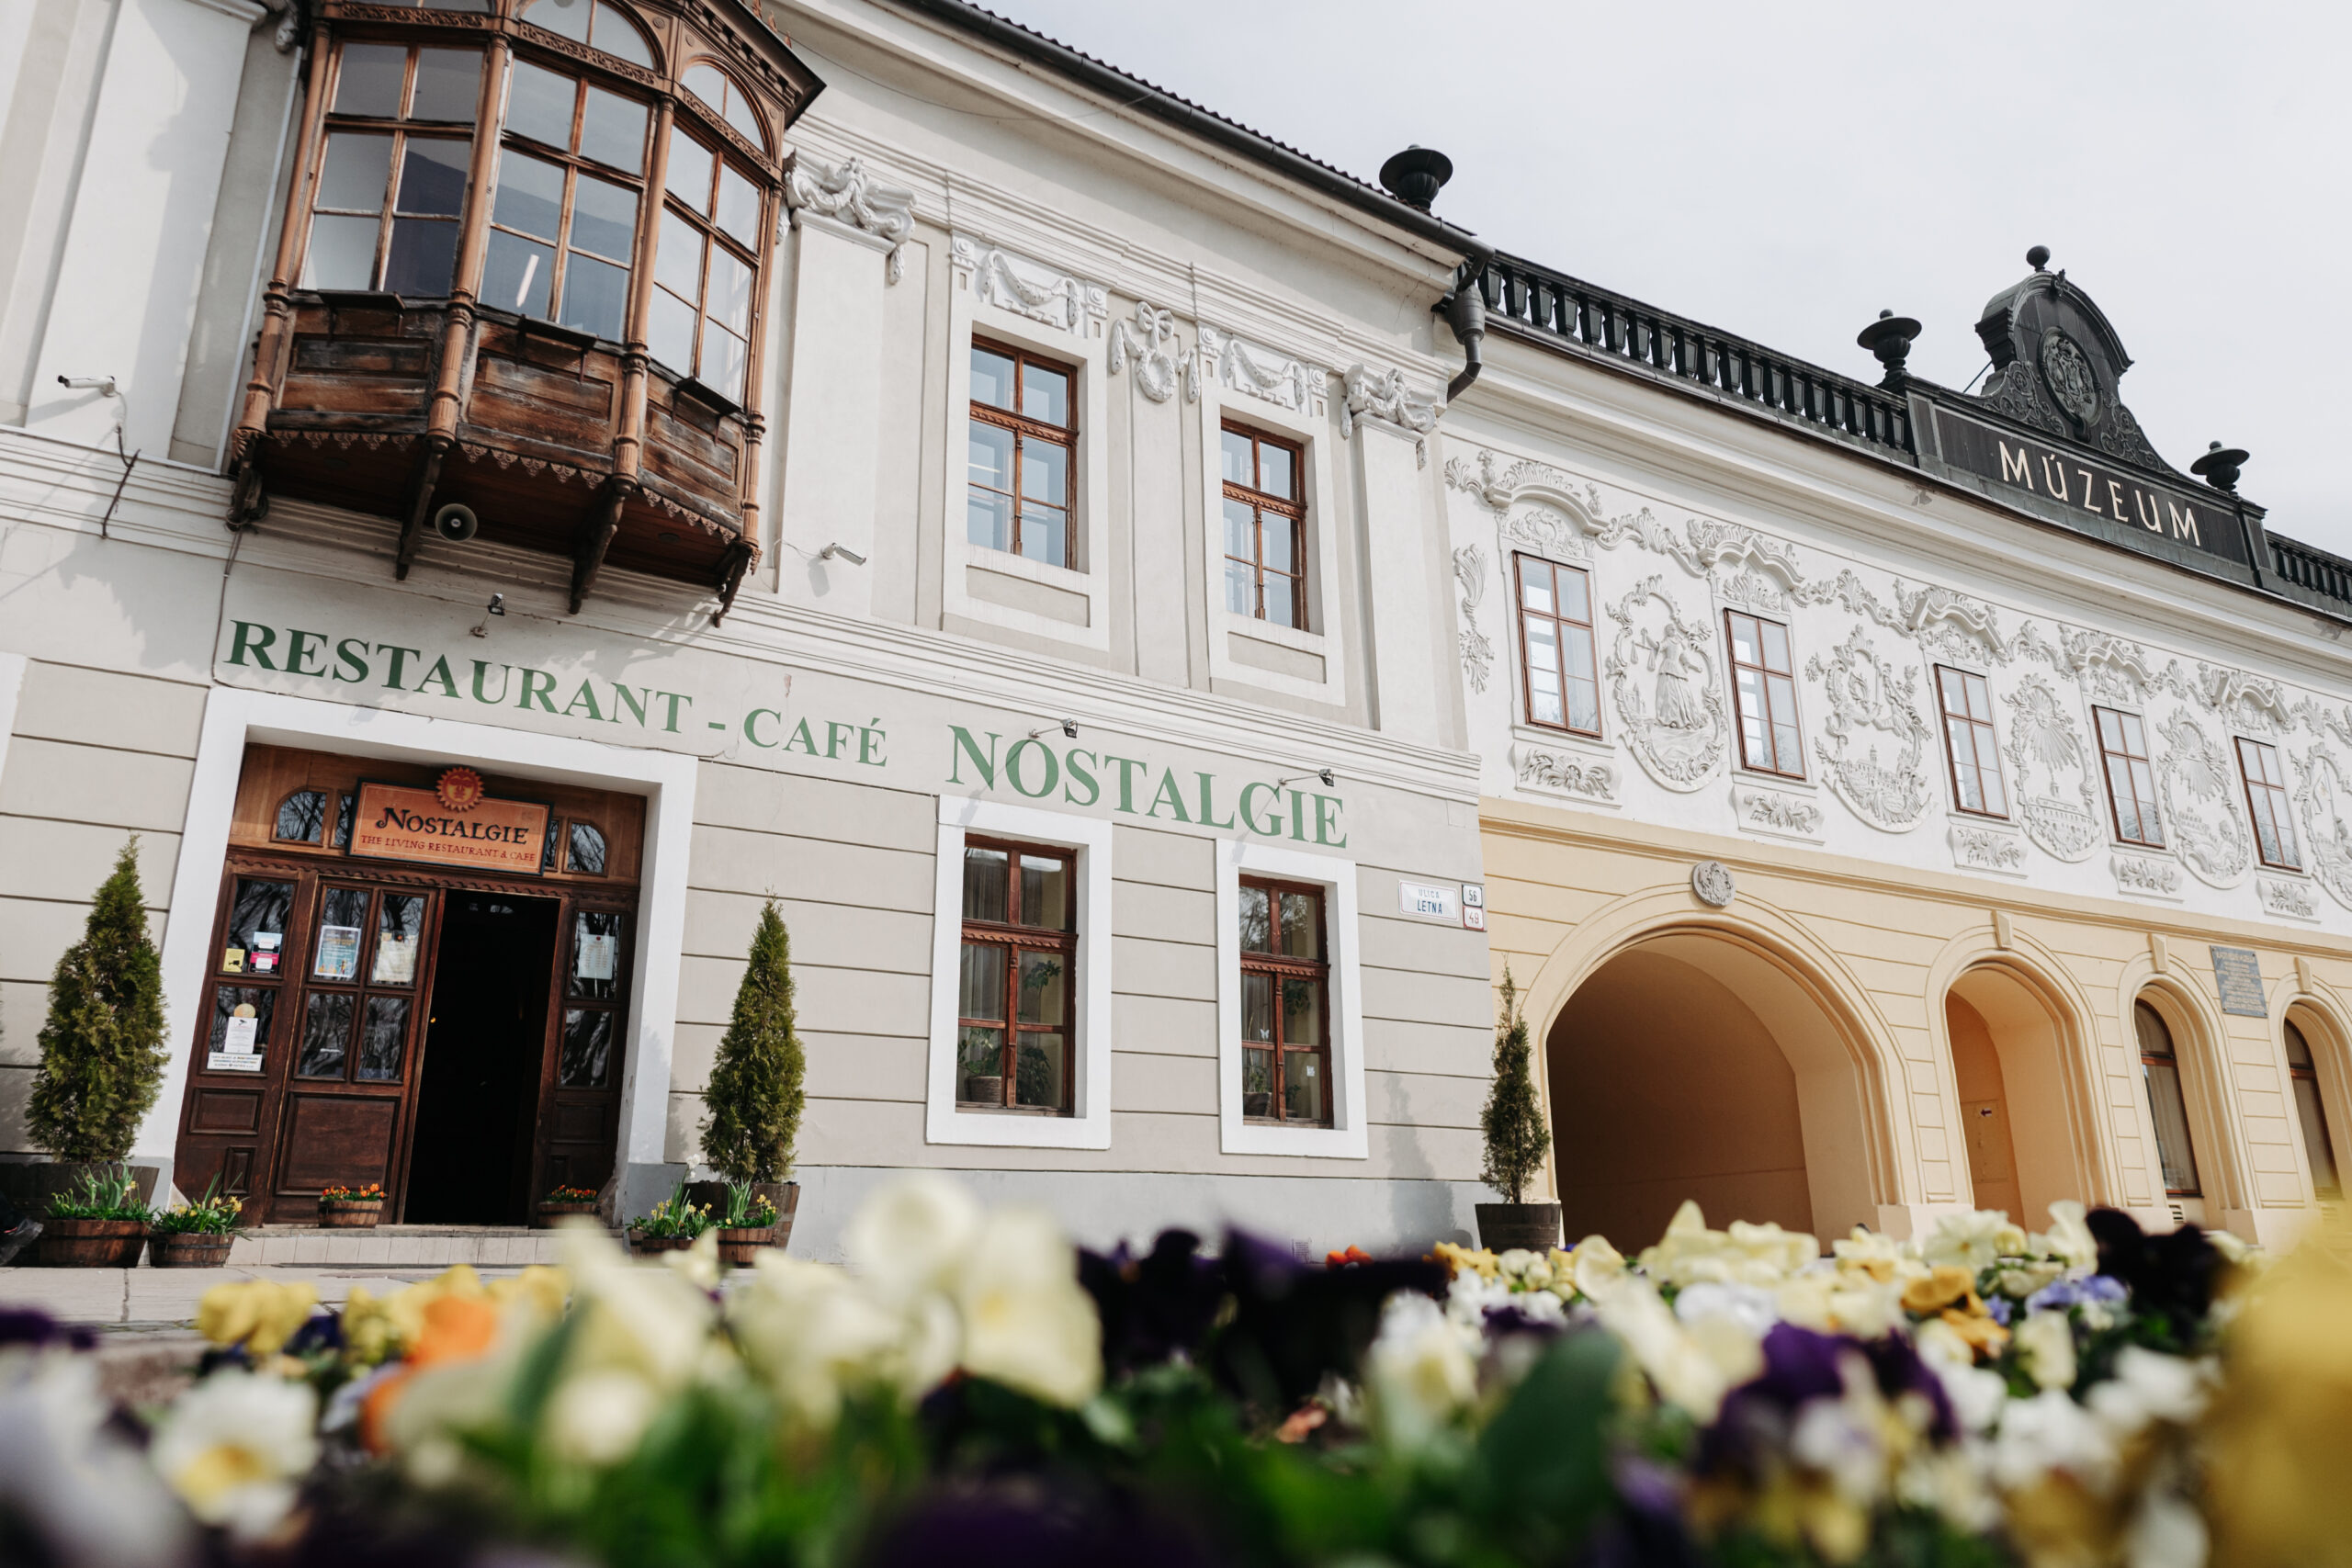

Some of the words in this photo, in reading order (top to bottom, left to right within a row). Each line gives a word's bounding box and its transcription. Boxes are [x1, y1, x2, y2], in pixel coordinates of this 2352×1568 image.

[1999, 441, 2200, 547] MÚZEUM
[223, 620, 693, 733] RESTAURANT
[743, 708, 888, 767] CAFÉ
[945, 725, 1348, 849] NOSTALGIE
[376, 807, 529, 845] NOSTALGIE
[361, 835, 382, 845] THE
[385, 838, 425, 851] LIVING
[428, 842, 498, 858] RESTAURANT
[500, 851, 507, 859] &
[1418, 888, 1440, 899] ULICA
[1468, 889, 1477, 903] 56
[1469, 912, 1479, 924] 49
